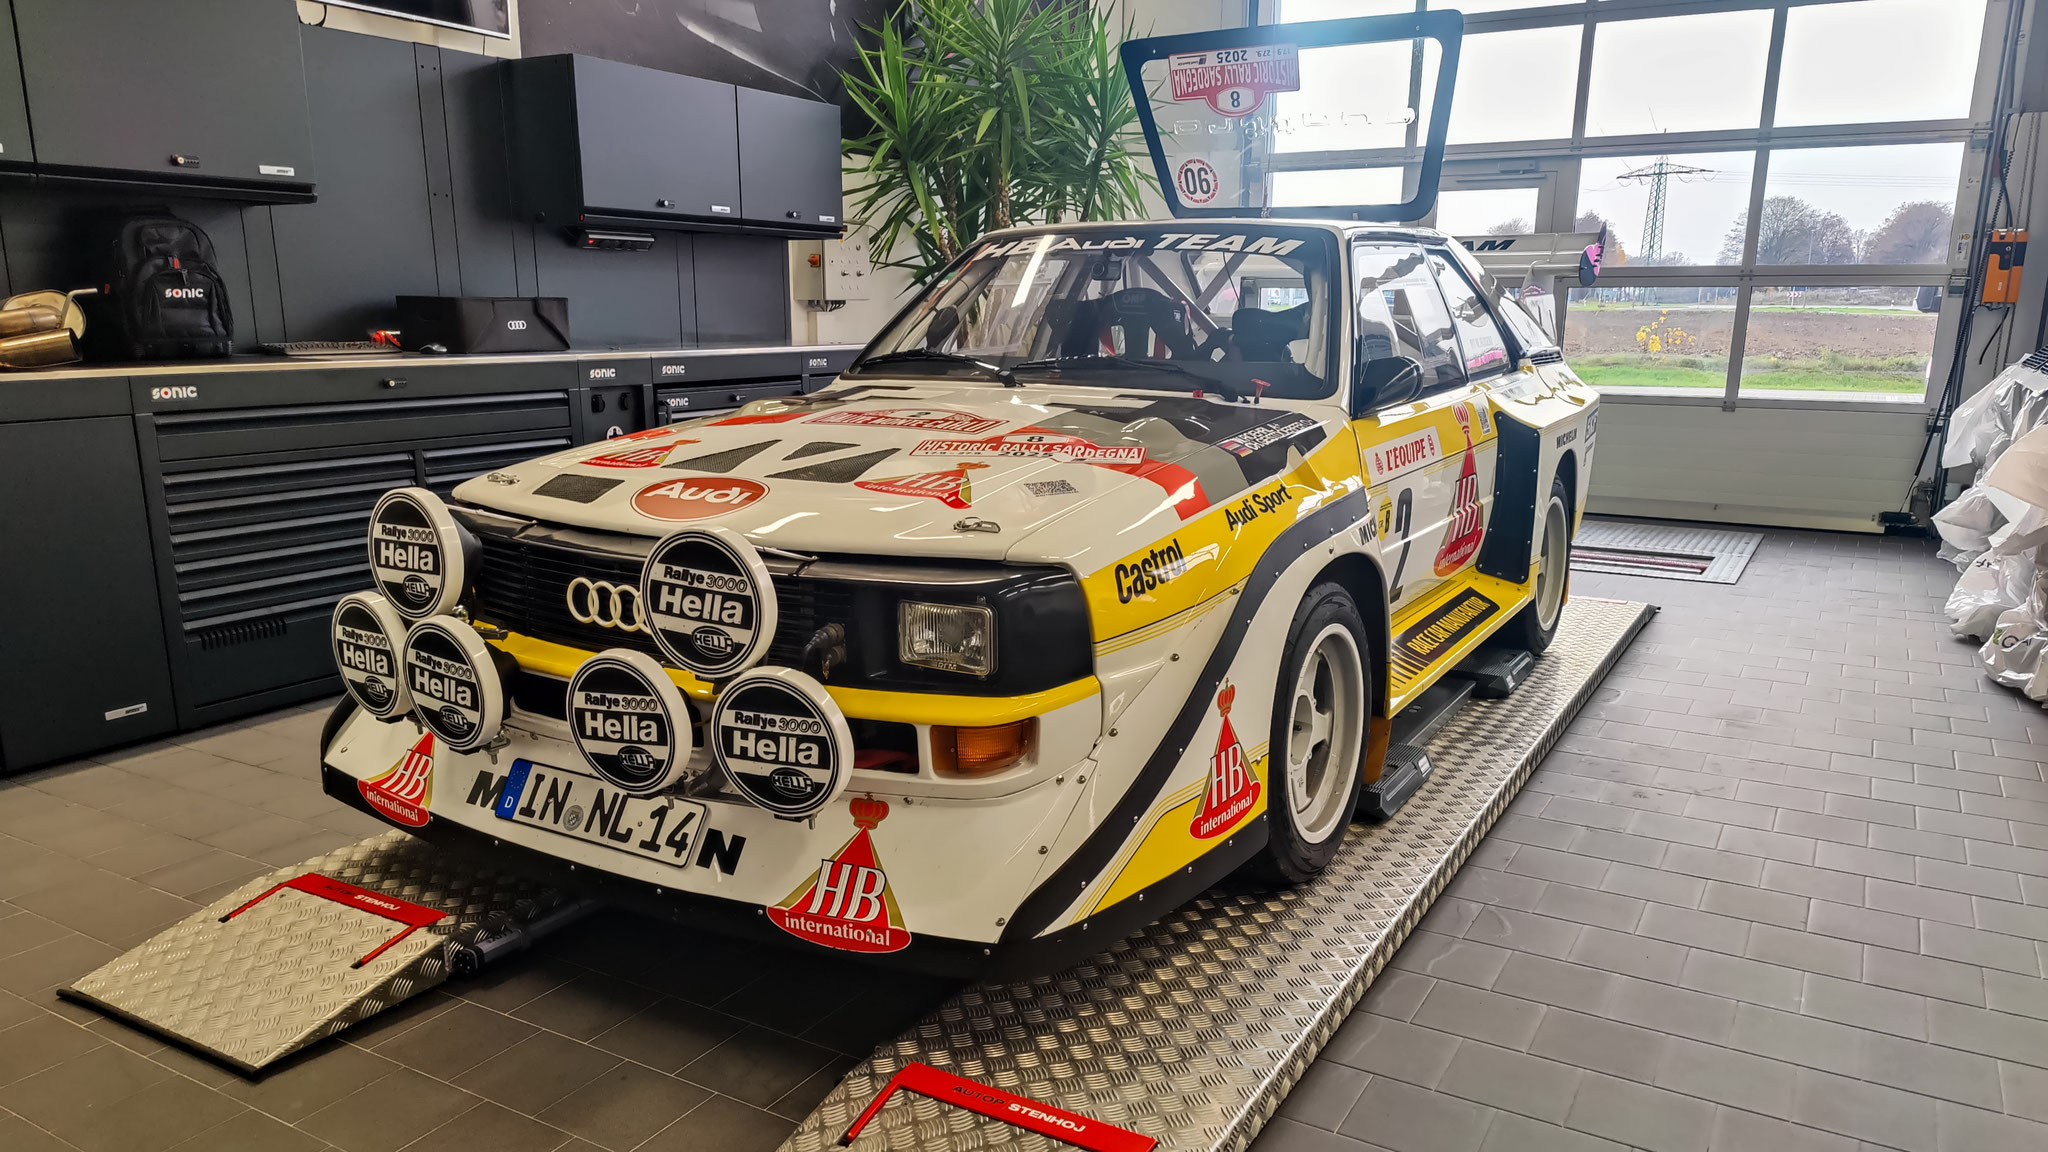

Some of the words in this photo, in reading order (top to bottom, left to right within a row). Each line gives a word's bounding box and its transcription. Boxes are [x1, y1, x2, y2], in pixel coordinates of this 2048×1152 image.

[1216, 50, 1248, 64] 2025
[1173, 67, 1222, 97] SARDEGNA
[1224, 63, 1252, 85] RALLY
[1254, 60, 1297, 87] HISTORIC
[1230, 91, 1241, 108] 8
[1184, 167, 1211, 196] 90
[1046, 237, 1146, 251] Audi
[1153, 233, 1306, 256] TEAM
[918, 441, 996, 451] HISTORIC
[999, 443, 1049, 452] RALLY
[1051, 445, 1141, 459] SARDEGNA
[1026, 435, 1044, 443] 8
[644, 482, 752, 505] Audi
[864, 482, 956, 503] international
[892, 472, 969, 490] HB
[1224, 500, 1258, 532] Audi
[1254, 483, 1293, 514] Sport
[1451, 474, 1478, 543] HB
[381, 525, 407, 540] Rallye
[408, 529, 434, 543] 3000
[1389, 488, 1412, 604] 2
[380, 541, 434, 572] Hella
[1438, 536, 1477, 570] international
[664, 566, 705, 586] Rallye
[706, 575, 748, 593] 3000
[1114, 538, 1187, 605] Castrol
[405, 581, 431, 598] HELLA
[658, 585, 744, 625] Hella
[1436, 596, 1491, 634] MANUFAKTUR
[342, 627, 364, 643] Rallye
[364, 633, 388, 648] 3000
[694, 633, 734, 652] HELLA
[1406, 633, 1440, 655] RACE
[1424, 624, 1452, 643] CAR
[342, 642, 388, 675] Hella
[415, 651, 442, 670] Rallye
[443, 661, 473, 680] 3000
[366, 682, 388, 699] HELLA
[415, 666, 472, 708] Hella
[584, 693, 620, 709] Rallye
[621, 697, 657, 711] 3000
[441, 711, 468, 730] HELLA
[584, 711, 658, 742] Hella
[734, 711, 777, 729] Rallye
[778, 718, 821, 734] 3000
[733, 730, 820, 765] Hella
[380, 749, 434, 800] HB
[620, 754, 656, 770] HELLA
[1210, 742, 1244, 810] HB
[772, 775, 814, 793] HELLA
[366, 786, 419, 822] international
[503, 795, 514, 809] D
[518, 773, 574, 824] IN
[584, 788, 634, 843] NL
[639, 804, 697, 858] 14
[1200, 793, 1252, 836] international
[807, 858, 887, 923] HB
[785, 912, 891, 946] international
[952, 1086, 1005, 1105] AUTOP
[1008, 1103, 1086, 1133] STENHOJ
